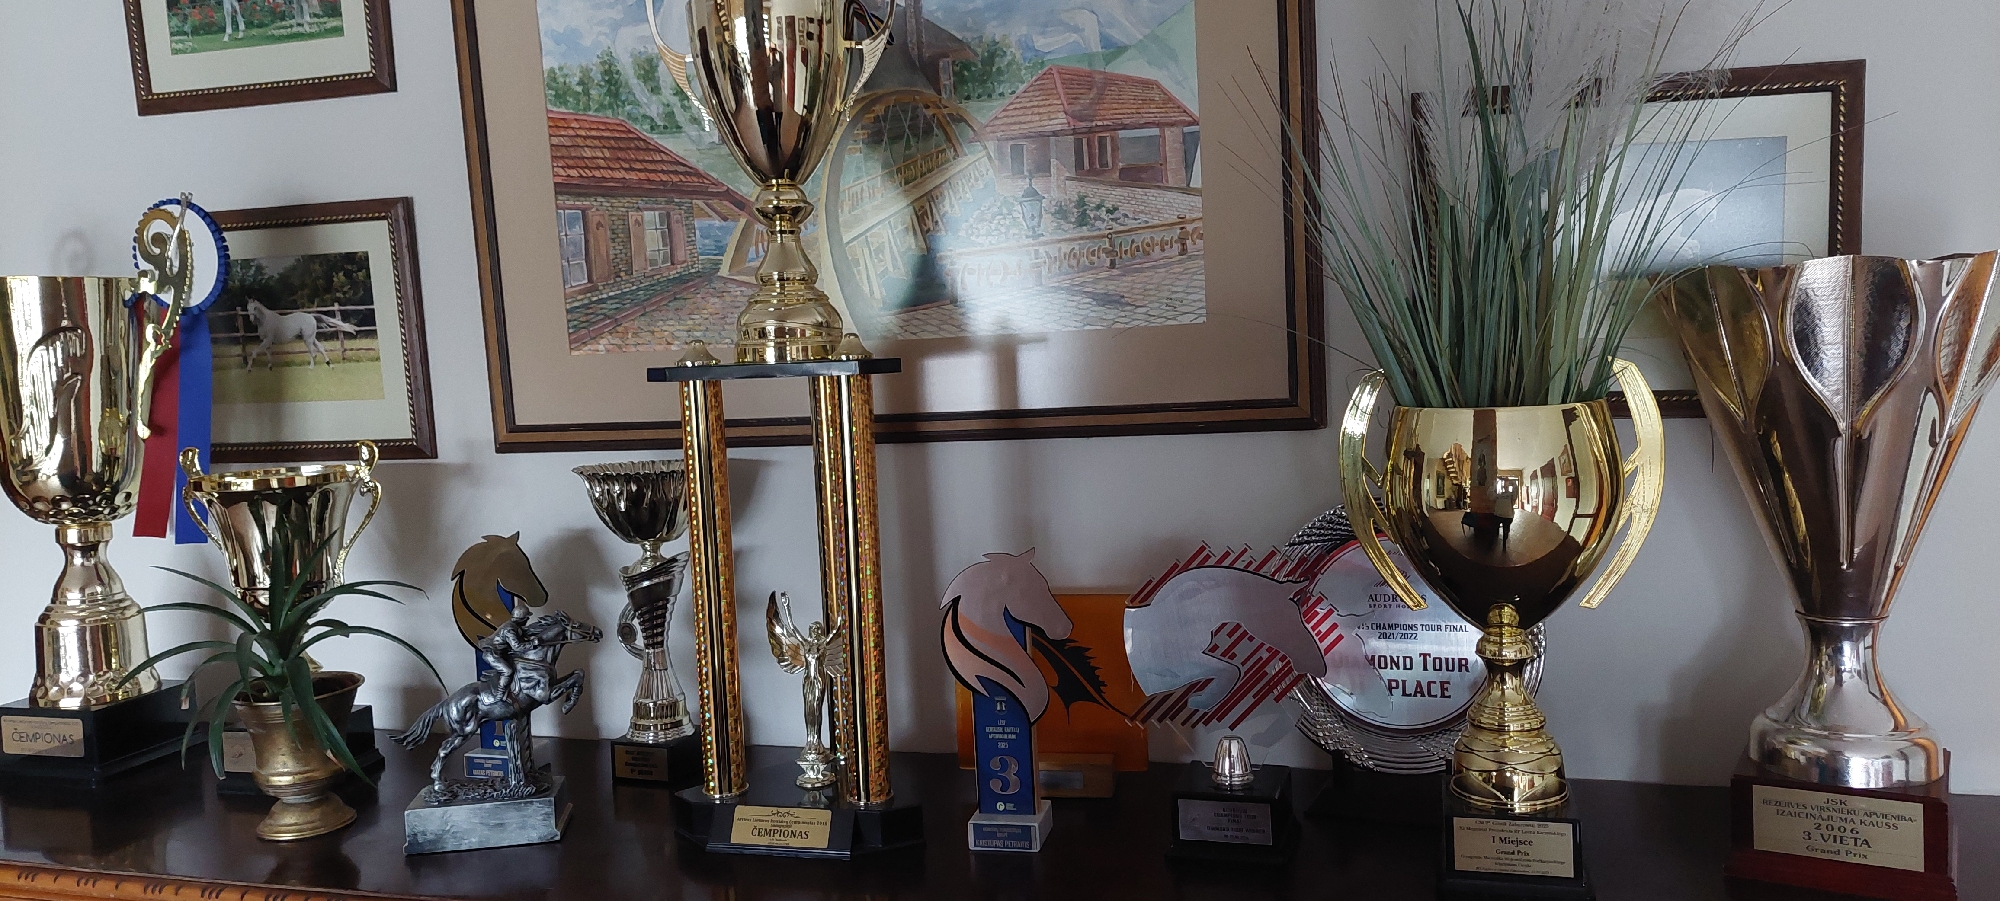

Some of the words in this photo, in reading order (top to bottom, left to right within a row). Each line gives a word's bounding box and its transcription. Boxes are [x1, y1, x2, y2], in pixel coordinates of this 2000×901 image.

[1368, 594, 1426, 604] AUDRS
[1371, 622, 1418, 632] CHAMPIONS
[1420, 623, 1442, 633] TOUR
[1444, 624, 1469, 633] FINAL
[1378, 632, 1418, 641] 2021/2022
[1387, 678, 1452, 699] PLACE
[12, 727, 75, 745] ČEMPIONAS
[989, 755, 1021, 795] 3
[1823, 797, 1848, 807] JSK
[1814, 822, 1860, 835] 2006
[1859, 818, 1899, 831] KAUSS
[751, 825, 810, 840] ČEMPIONAS
[1491, 835, 1497, 844] I
[1499, 835, 1534, 848] Miejsce
[1495, 848, 1515, 857] Grand
[1517, 849, 1531, 858] Prix
[1806, 845, 1841, 857] Grand
[1845, 850, 1869, 860] Prix
